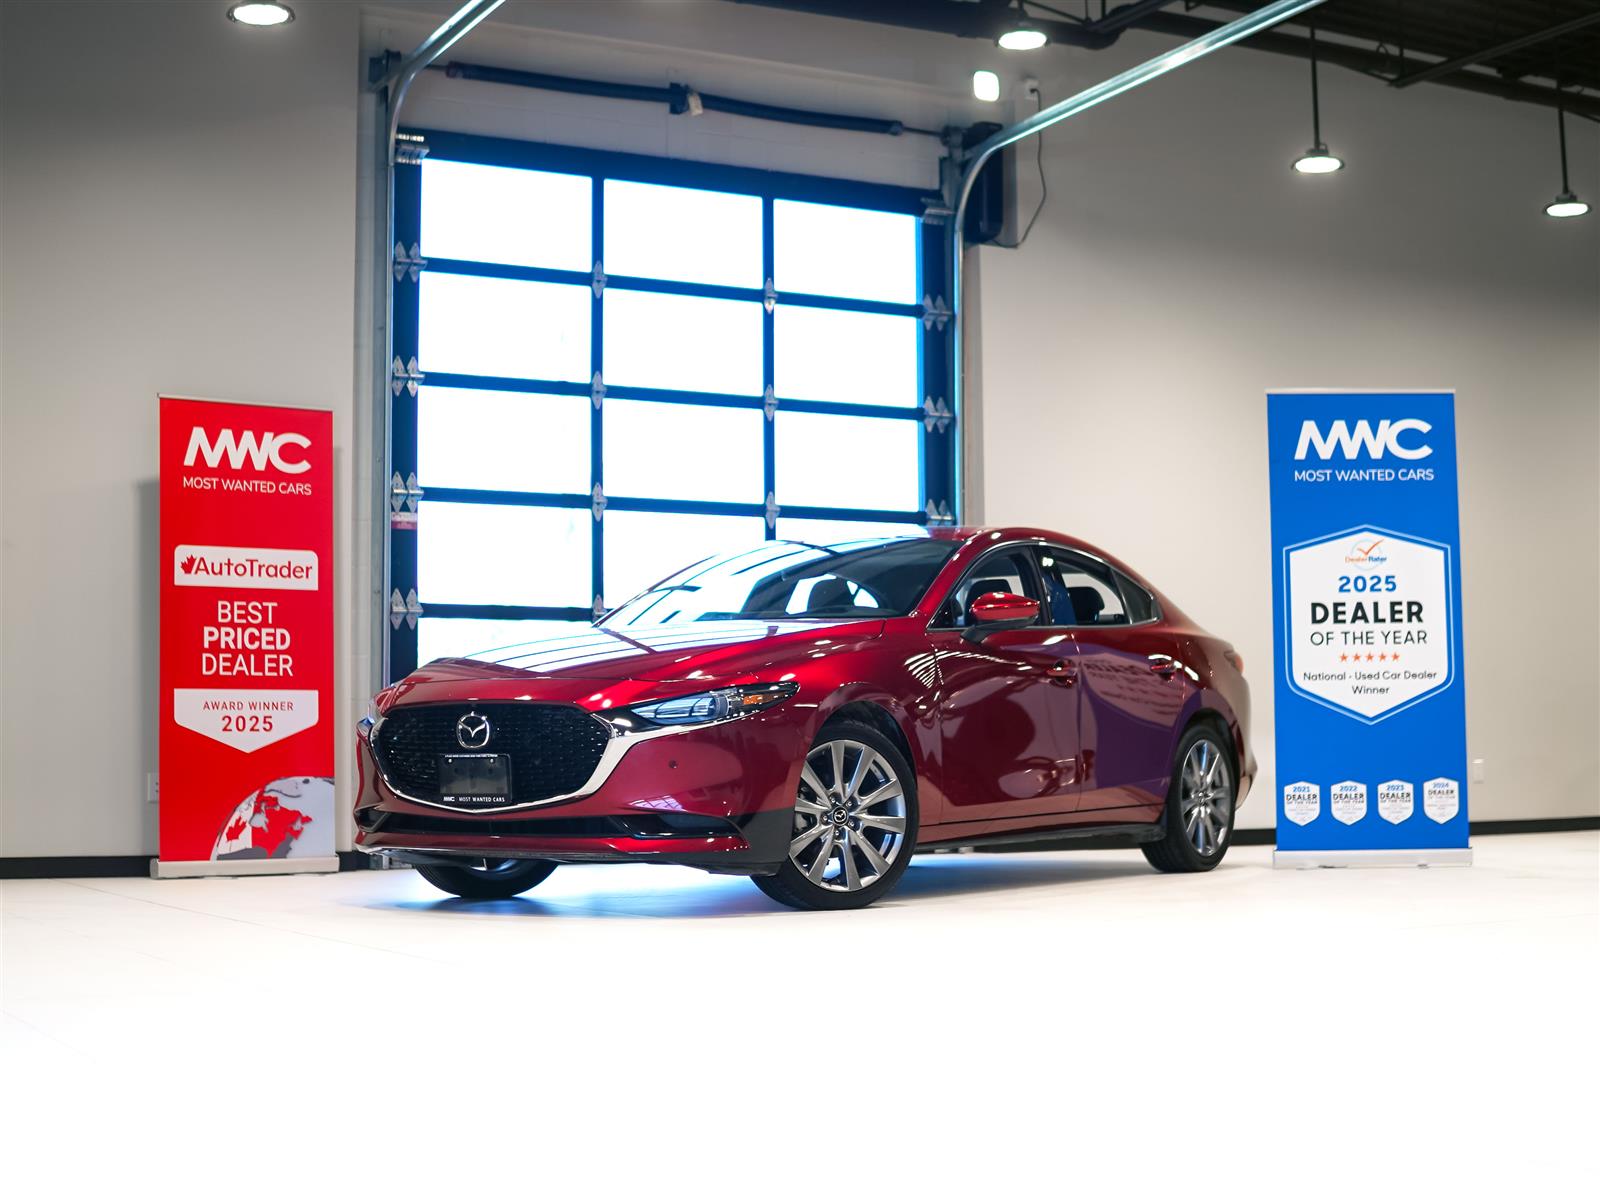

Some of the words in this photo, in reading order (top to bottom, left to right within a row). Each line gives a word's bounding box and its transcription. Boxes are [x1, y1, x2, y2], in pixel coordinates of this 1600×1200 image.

[1294, 418, 1433, 461] MWC
[183, 426, 312, 474] MWC
[1294, 469, 1332, 482] MOST
[1336, 469, 1395, 481] WANTED
[1398, 468, 1435, 481] CARS
[183, 476, 219, 490] MOST
[221, 479, 276, 494] WANTED
[278, 482, 312, 496] CARS
[194, 556, 313, 579] AutoTrader
[1338, 575, 1397, 593] 2025
[217, 600, 278, 624] BEST
[1310, 601, 1424, 625] DEALER
[203, 626, 291, 651] PRICED
[1310, 631, 1334, 646] OF
[1341, 630, 1375, 645] THE
[1381, 630, 1427, 645] YEAR
[202, 653, 293, 677] DEALER
[1303, 671, 1346, 681] National
[1354, 671, 1380, 681] Used
[1382, 671, 1401, 680] Car
[1404, 670, 1437, 680] Dealer
[1351, 686, 1390, 695] Winner
[203, 701, 244, 711] AWARD
[248, 701, 294, 711] WINNER
[221, 715, 273, 732] 2025
[1380, 792, 1411, 800] DEALER
